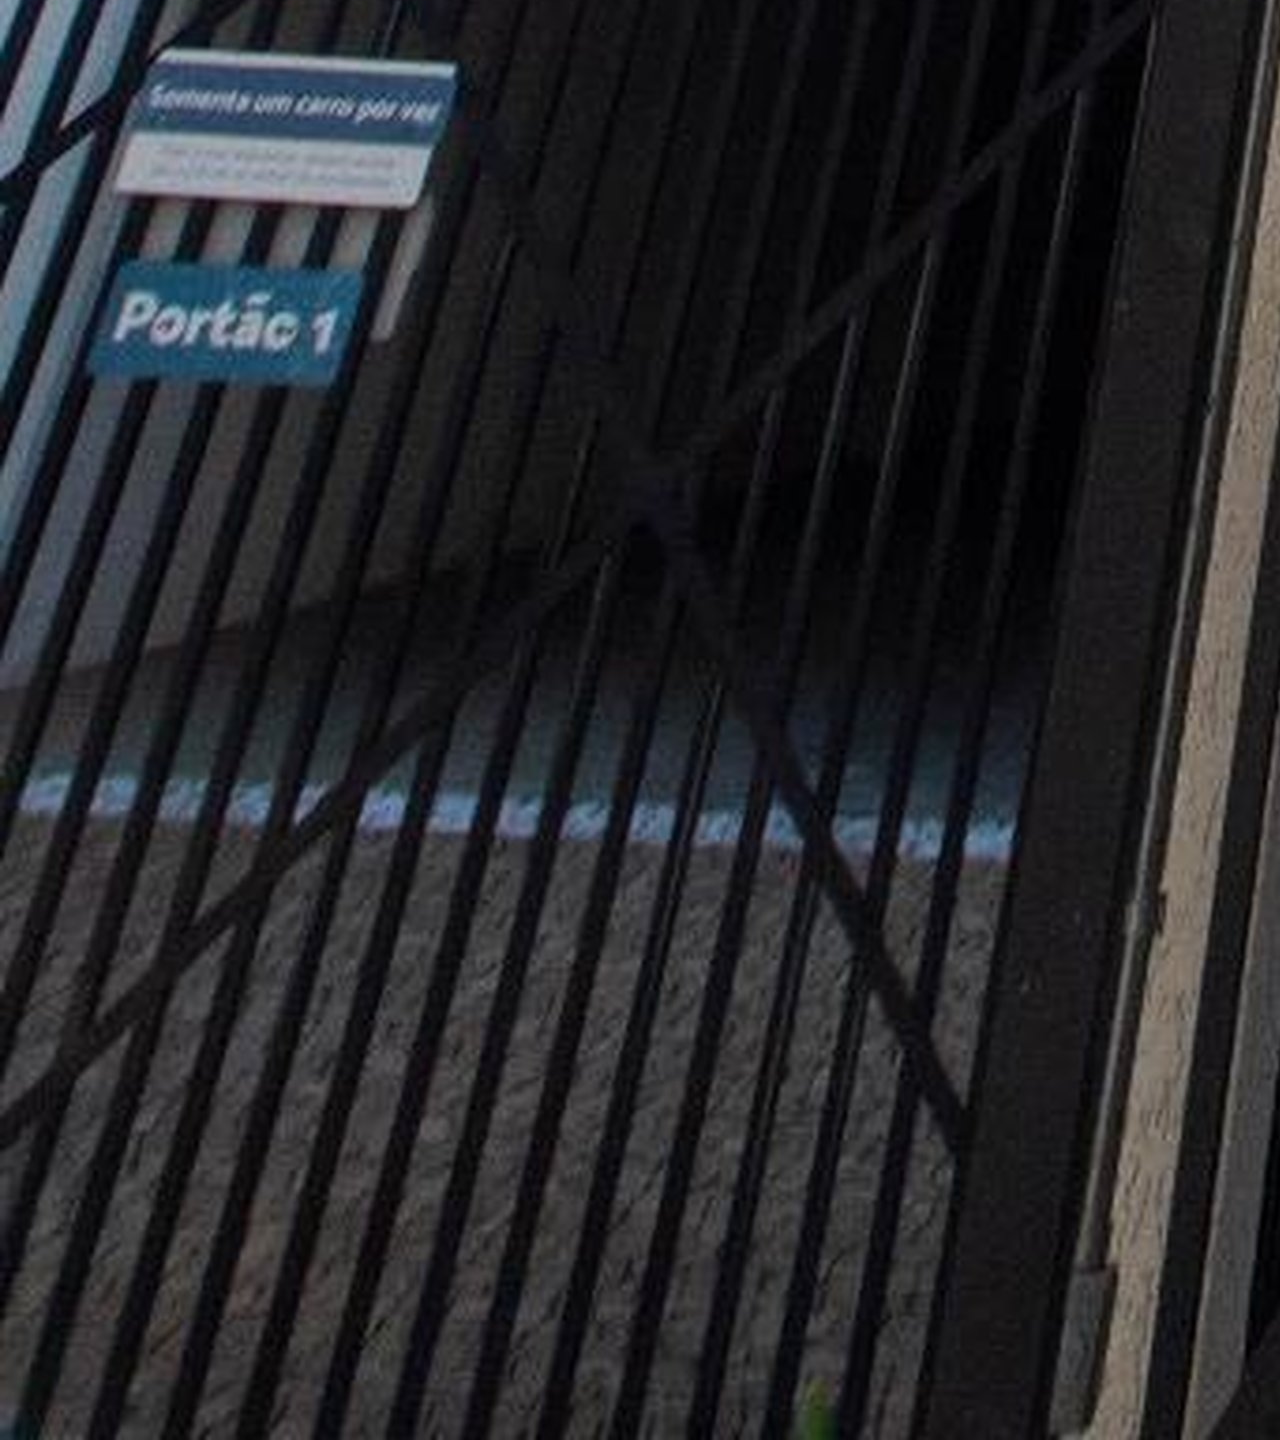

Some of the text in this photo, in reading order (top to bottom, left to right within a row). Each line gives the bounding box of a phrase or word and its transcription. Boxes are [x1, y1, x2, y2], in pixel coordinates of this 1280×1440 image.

[149, 82, 250, 114] Somente
[253, 91, 296, 114] um
[295, 93, 354, 119] carro
[353, 100, 398, 125] por
[113, 291, 340, 355] Portão 1
